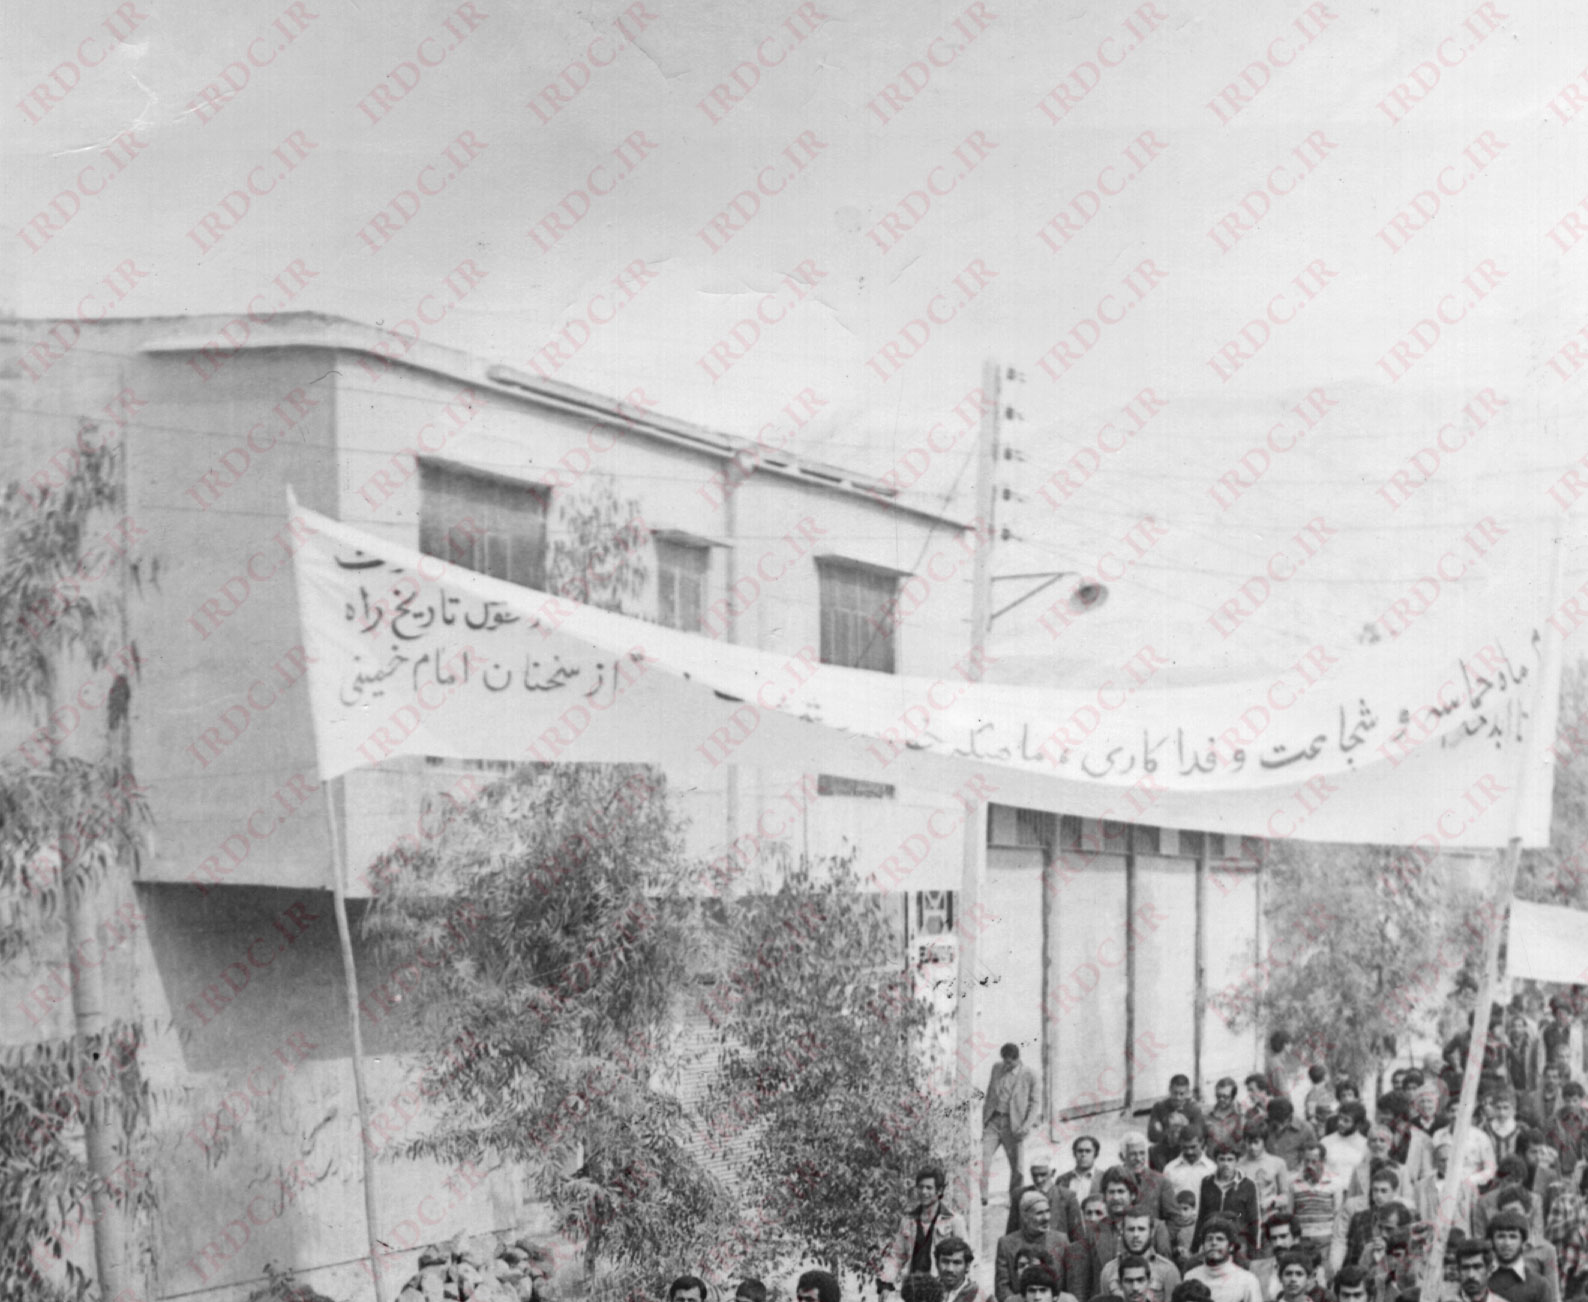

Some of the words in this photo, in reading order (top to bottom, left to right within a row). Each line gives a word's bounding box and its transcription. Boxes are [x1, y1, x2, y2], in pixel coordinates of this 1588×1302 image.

[345, 586, 384, 634] راه
[391, 587, 461, 640] تاریخ
[339, 644, 409, 707] خمینی
[413, 647, 469, 693] امام
[584, 661, 619, 698] از
[1230, 747, 1247, 773] و
